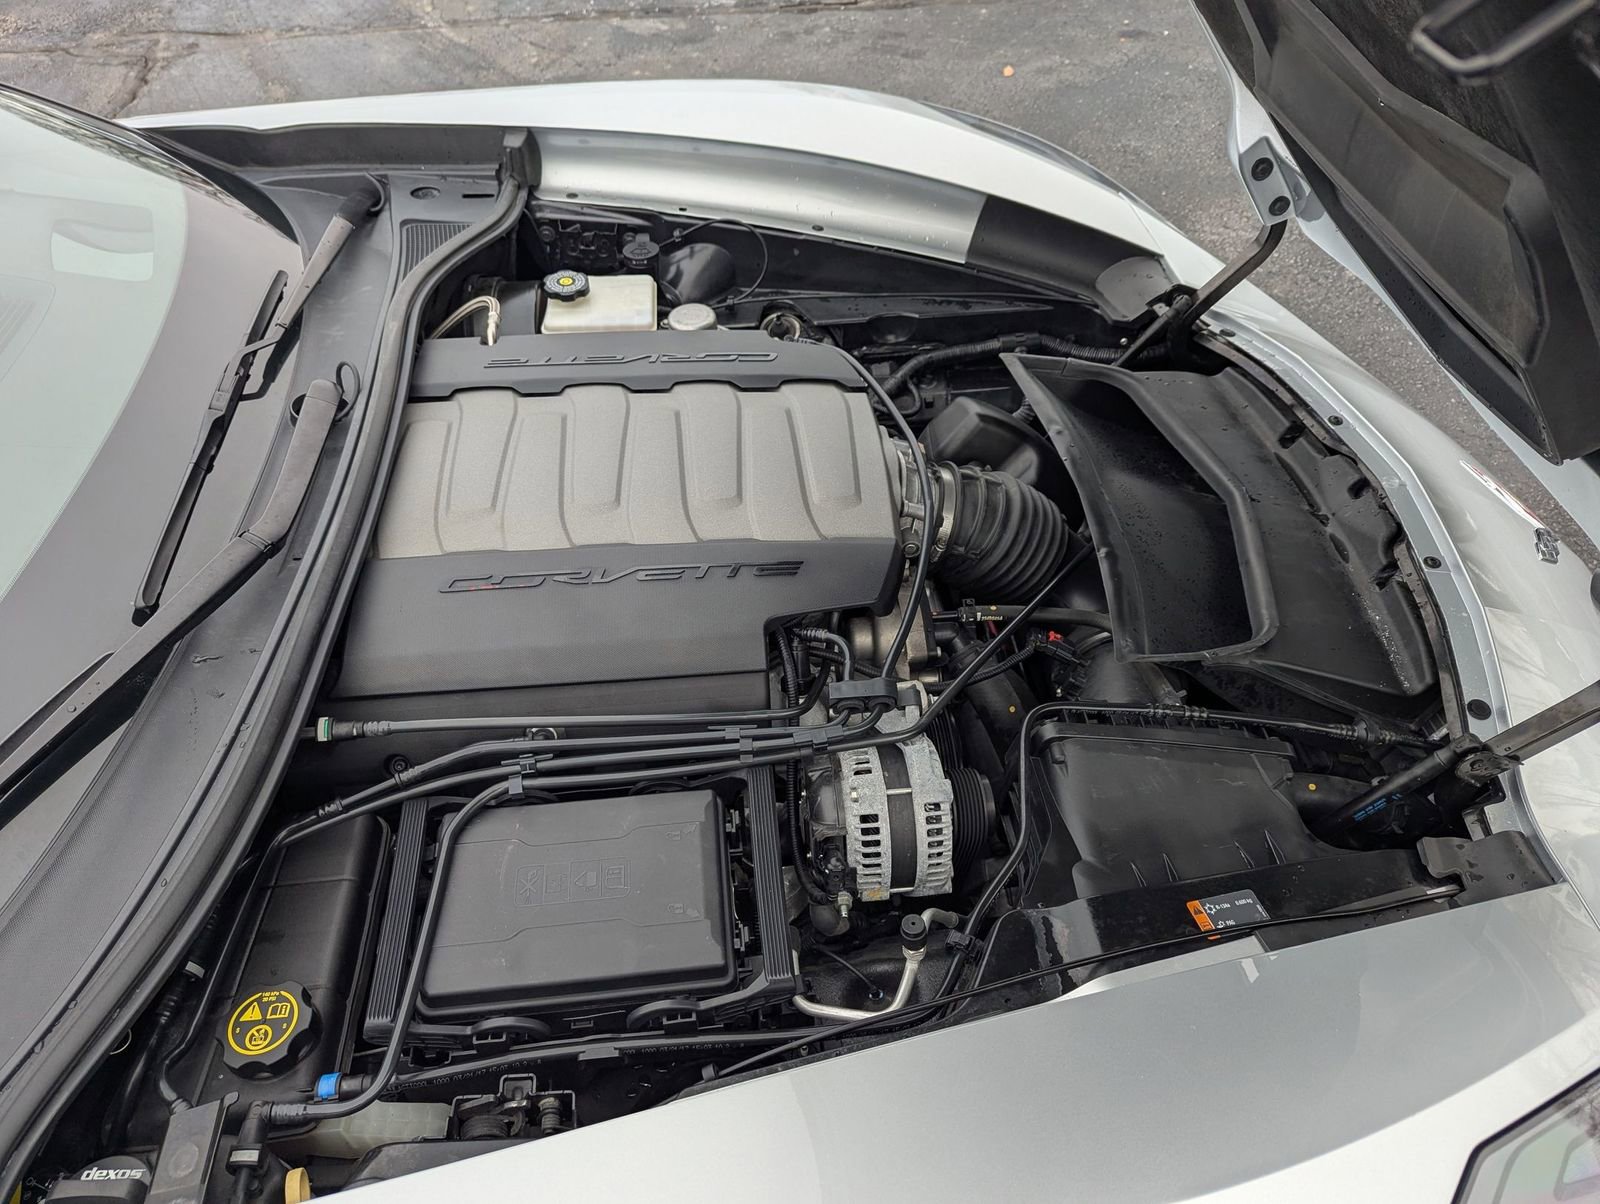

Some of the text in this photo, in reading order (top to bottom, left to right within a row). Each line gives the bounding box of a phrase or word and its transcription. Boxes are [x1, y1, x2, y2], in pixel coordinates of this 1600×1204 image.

[483, 351, 779, 369] CORVETTE
[438, 560, 805, 594] CORVETTE
[80, 1166, 147, 1181] dexos
